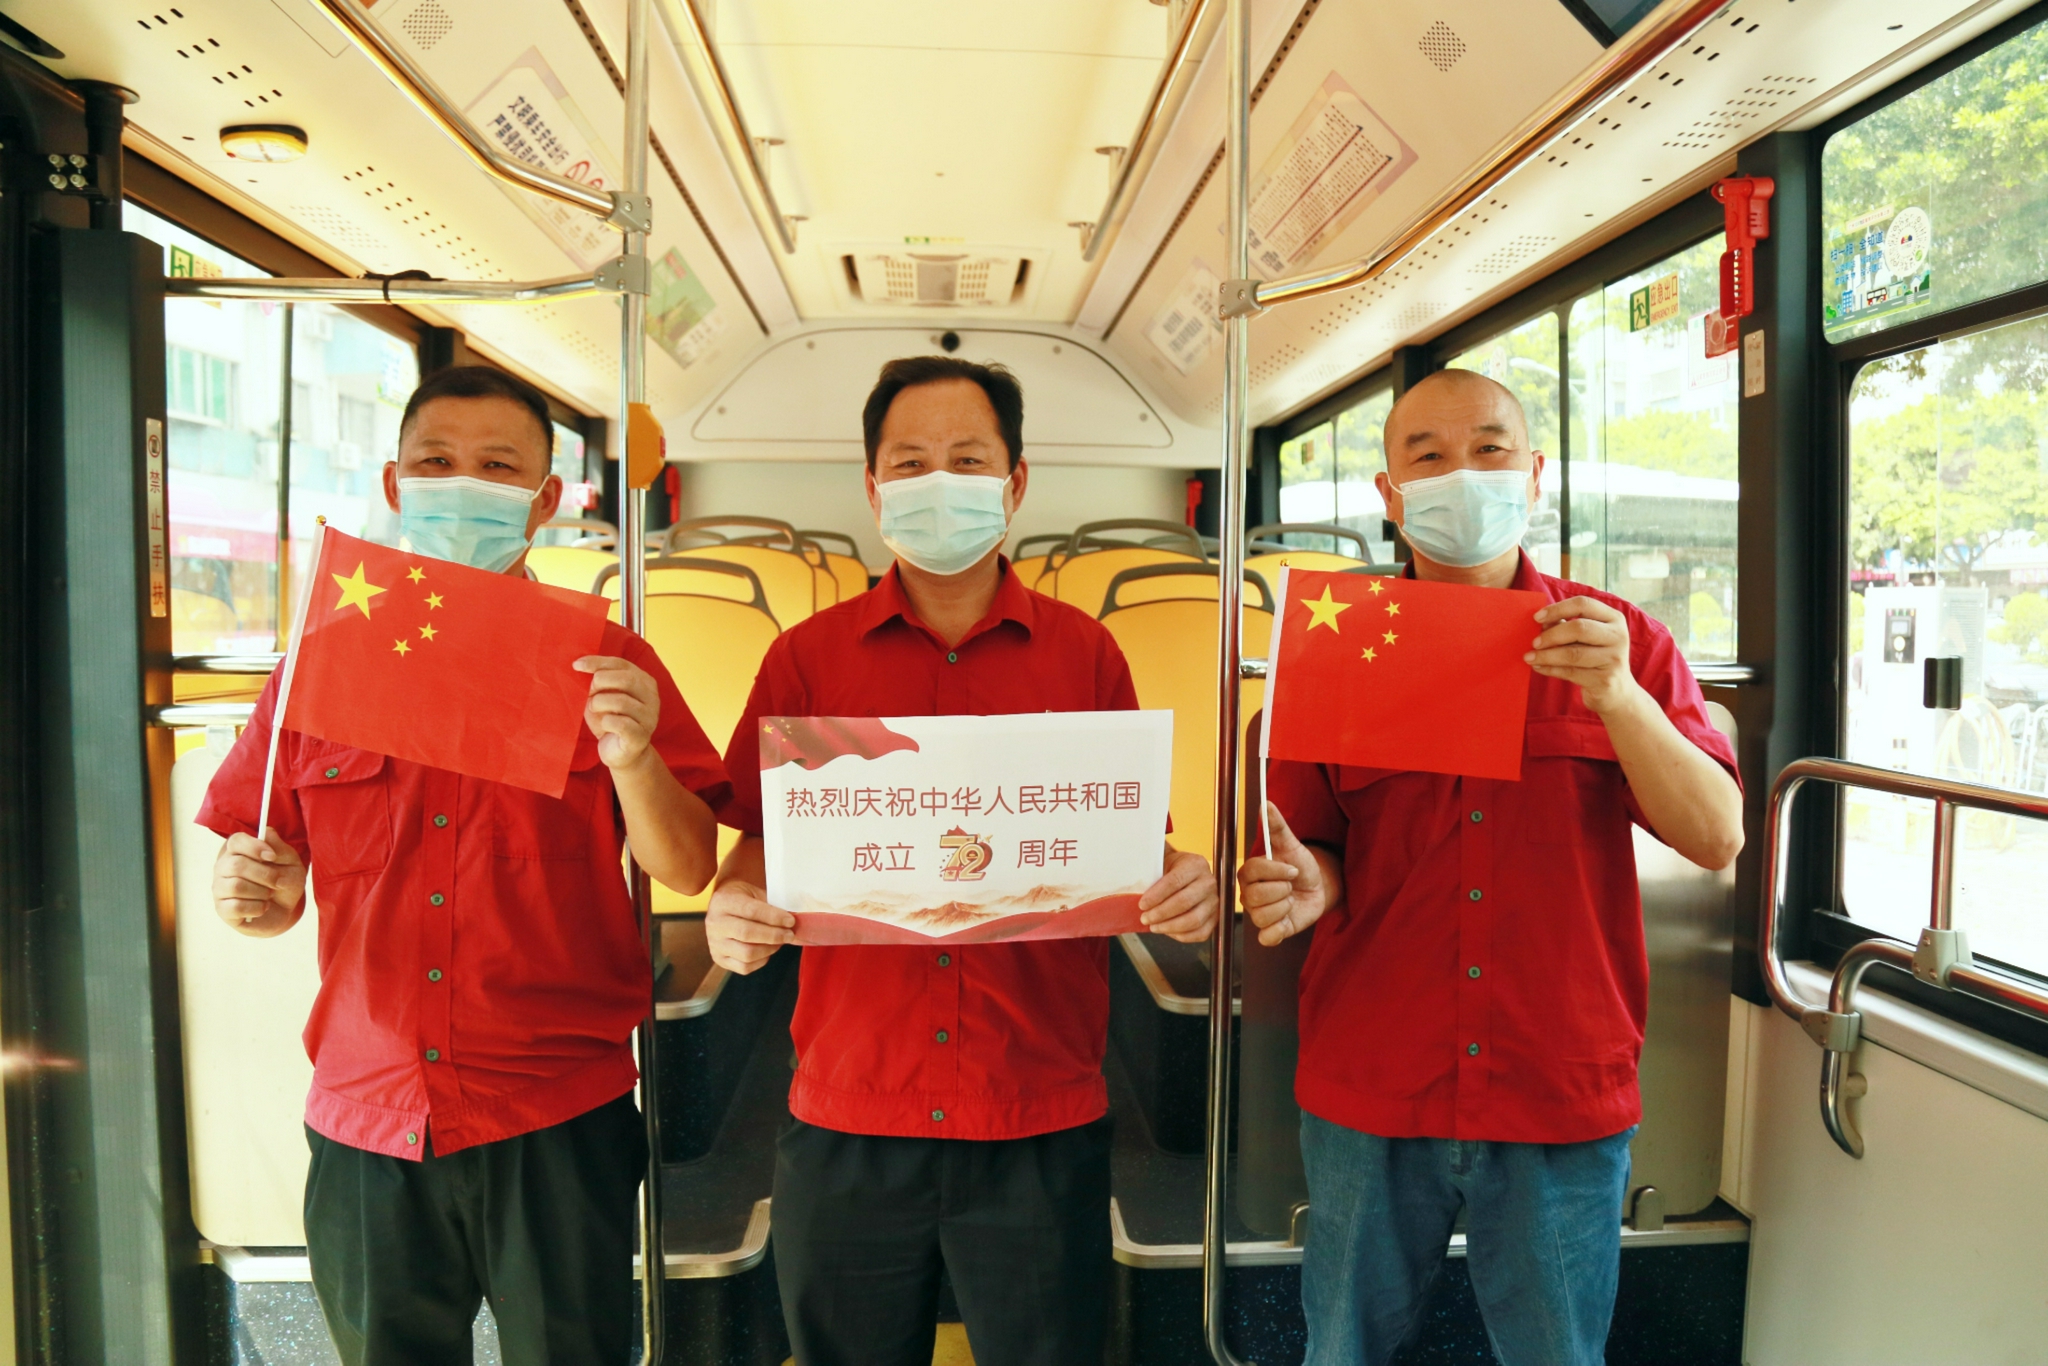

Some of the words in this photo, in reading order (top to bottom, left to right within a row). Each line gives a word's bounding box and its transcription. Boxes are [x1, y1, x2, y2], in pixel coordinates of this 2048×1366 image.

[506, 94, 570, 166] 文明乘车安全出行
[1859, 231, 1883, 251] 全知道
[1650, 275, 1678, 307] 应急出口
[1650, 306, 1670, 322] EMERGENCY
[149, 468, 166, 606] 禁止手扶
[786, 781, 1141, 818] 热烈庆祝中华人民共和国
[852, 841, 916, 872] 成立
[1016, 838, 1079, 869] 周年
